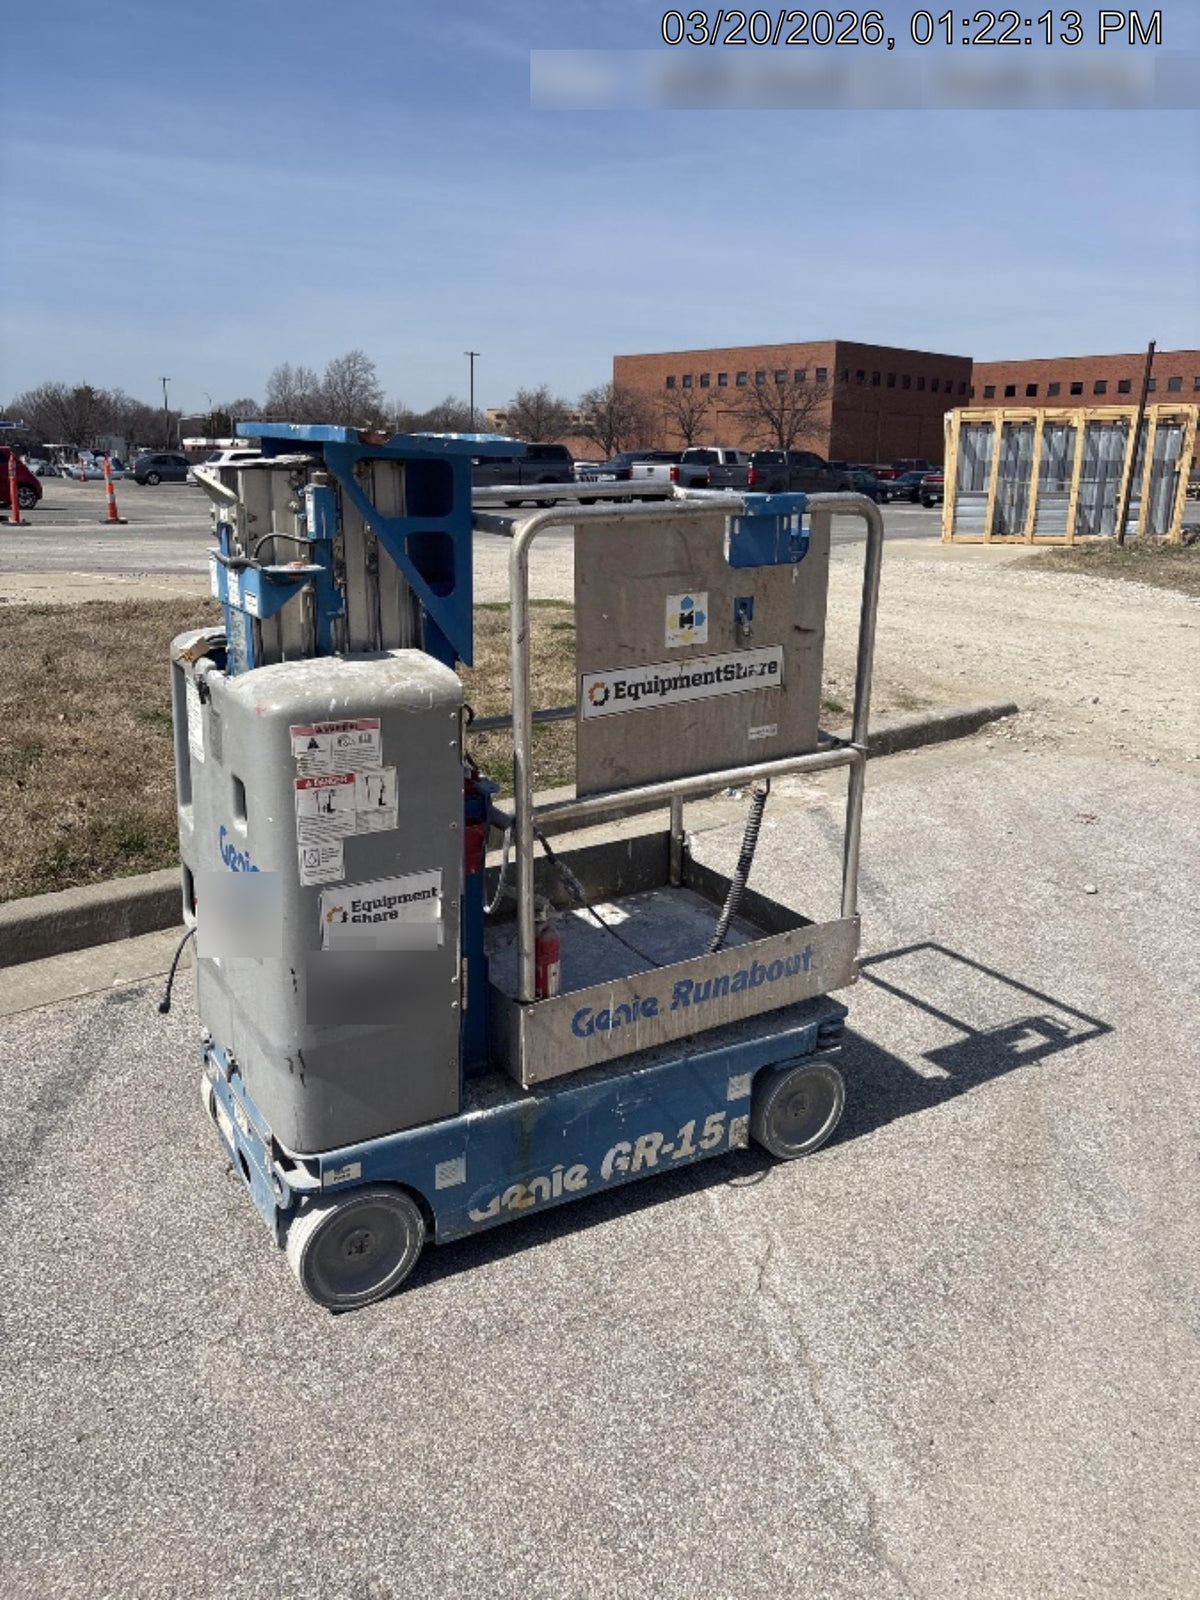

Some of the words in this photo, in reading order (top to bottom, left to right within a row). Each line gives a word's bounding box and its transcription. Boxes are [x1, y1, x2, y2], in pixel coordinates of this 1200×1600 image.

[351, 886, 438, 913] Equipment
[571, 994, 659, 1038] Genie
[671, 945, 813, 1010] Runabout
[600, 1111, 726, 1180] GR-15
